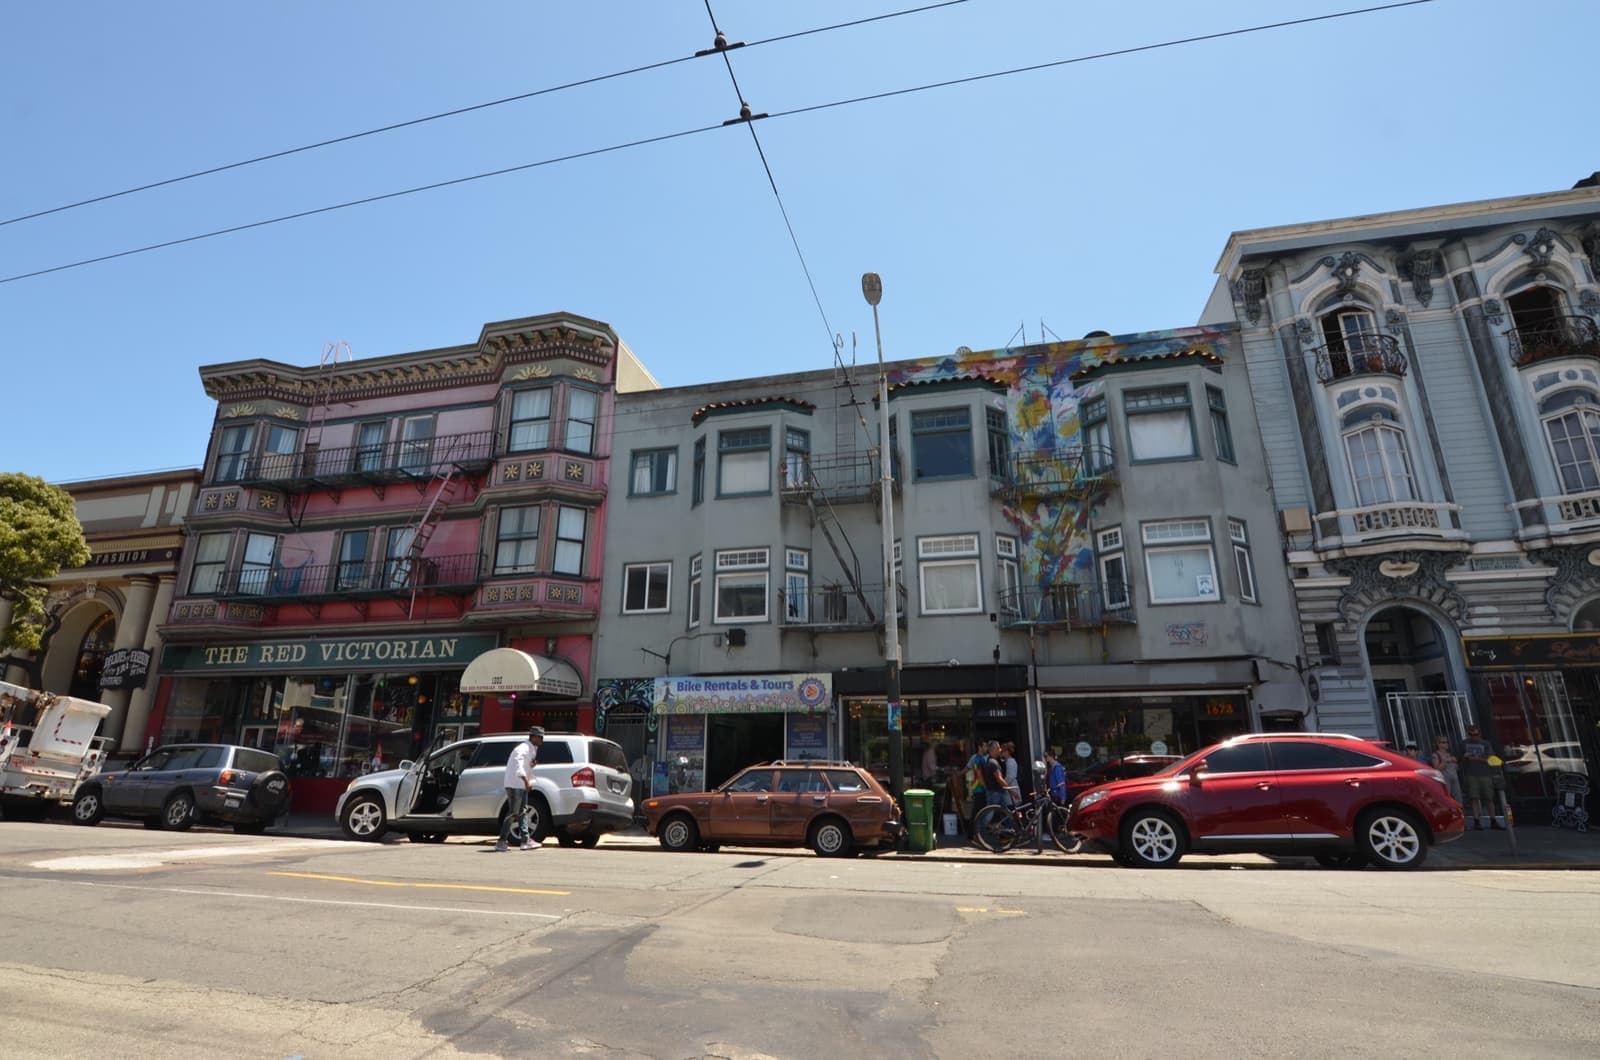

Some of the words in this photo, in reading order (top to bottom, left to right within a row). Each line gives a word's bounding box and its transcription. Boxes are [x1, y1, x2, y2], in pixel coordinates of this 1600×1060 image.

[96, 551, 148, 564] FASHION
[205, 647, 248, 664] THE
[259, 644, 306, 663] RED
[320, 638, 458, 661] VICTORIAN
[676, 680, 702, 692] Bike
[704, 679, 748, 691] Rentals
[750, 679, 760, 690] &
[762, 679, 794, 690] Tours
